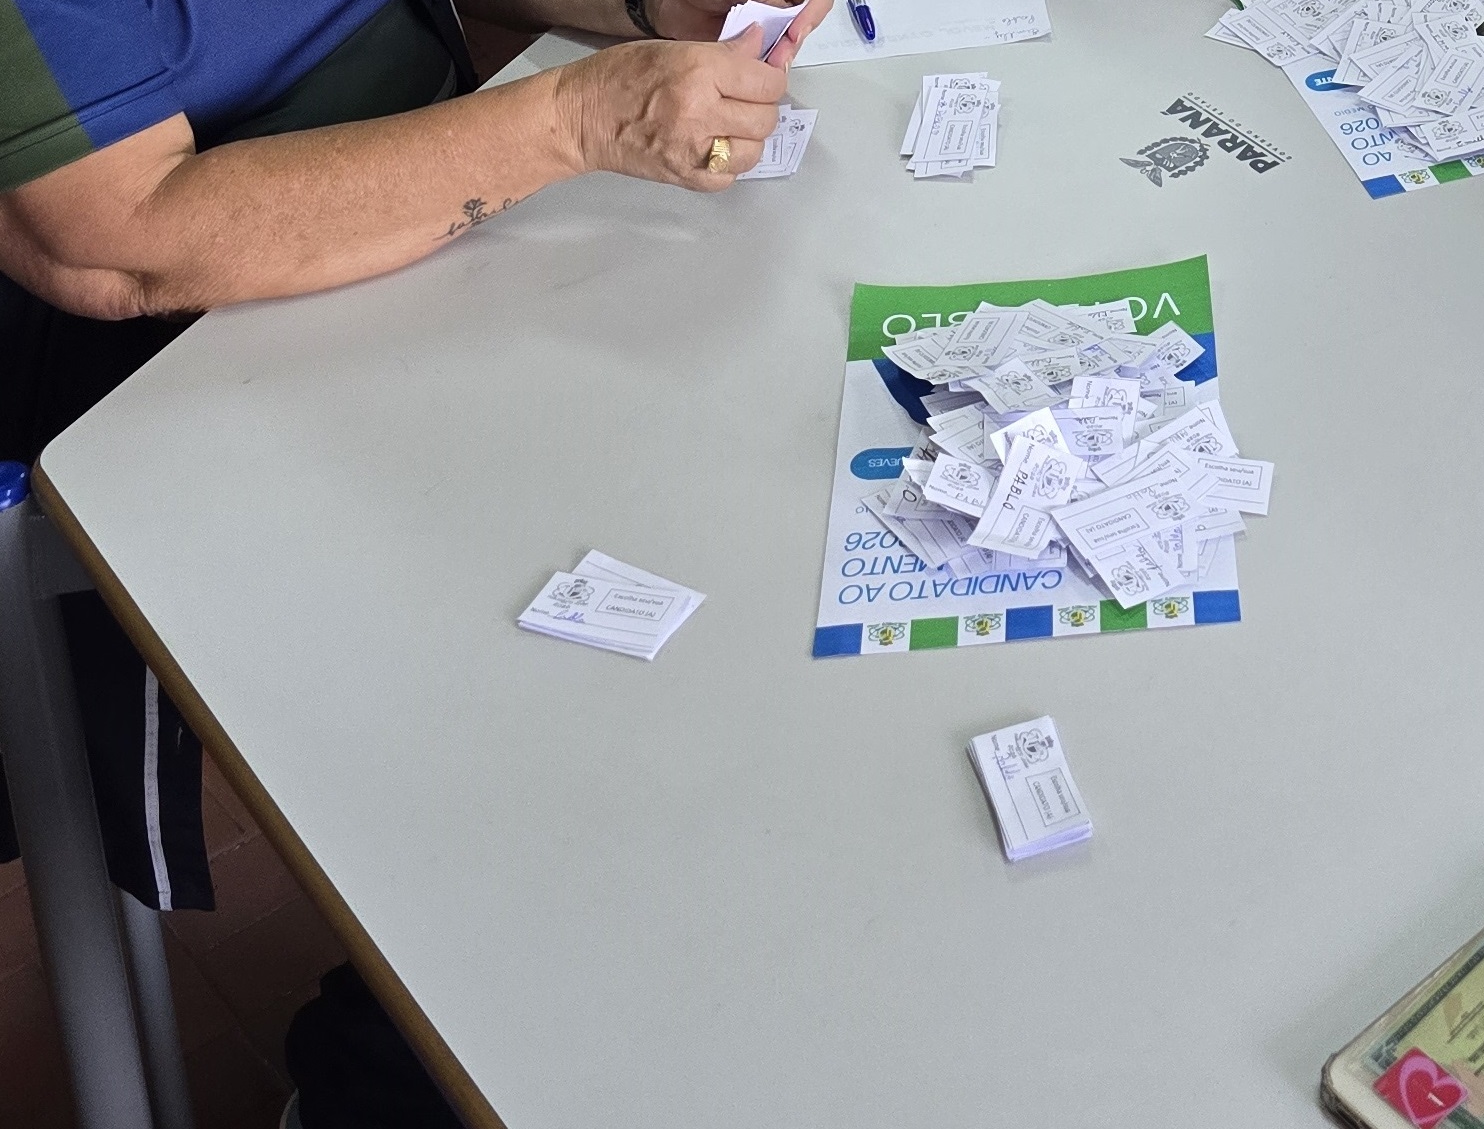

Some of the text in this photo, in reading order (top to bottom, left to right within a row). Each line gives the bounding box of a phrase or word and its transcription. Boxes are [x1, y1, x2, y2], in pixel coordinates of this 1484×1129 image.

[1340, 117, 1379, 135] 026
[1160, 98, 1280, 174] PARANÁ
[1362, 151, 1392, 166] AO
[1084, 380, 1093, 400] Nome
[1023, 443, 1035, 464] Nome
[1204, 462, 1228, 472] Escolha
[1003, 470, 1027, 510] PABLO
[1159, 477, 1178, 488] Nome
[1085, 513, 1131, 534] CANDIDATO (A)
[1117, 522, 1140, 537] Escolha
[838, 569, 1062, 604] AO CANDIDATO
[1158, 570, 1170, 586] Nome
[613, 593, 636, 603] Escolha
[605, 604, 644, 616] CANDIDATO
[989, 734, 1003, 752] Nome
[1031, 780, 1052, 812] CANDIDATO
